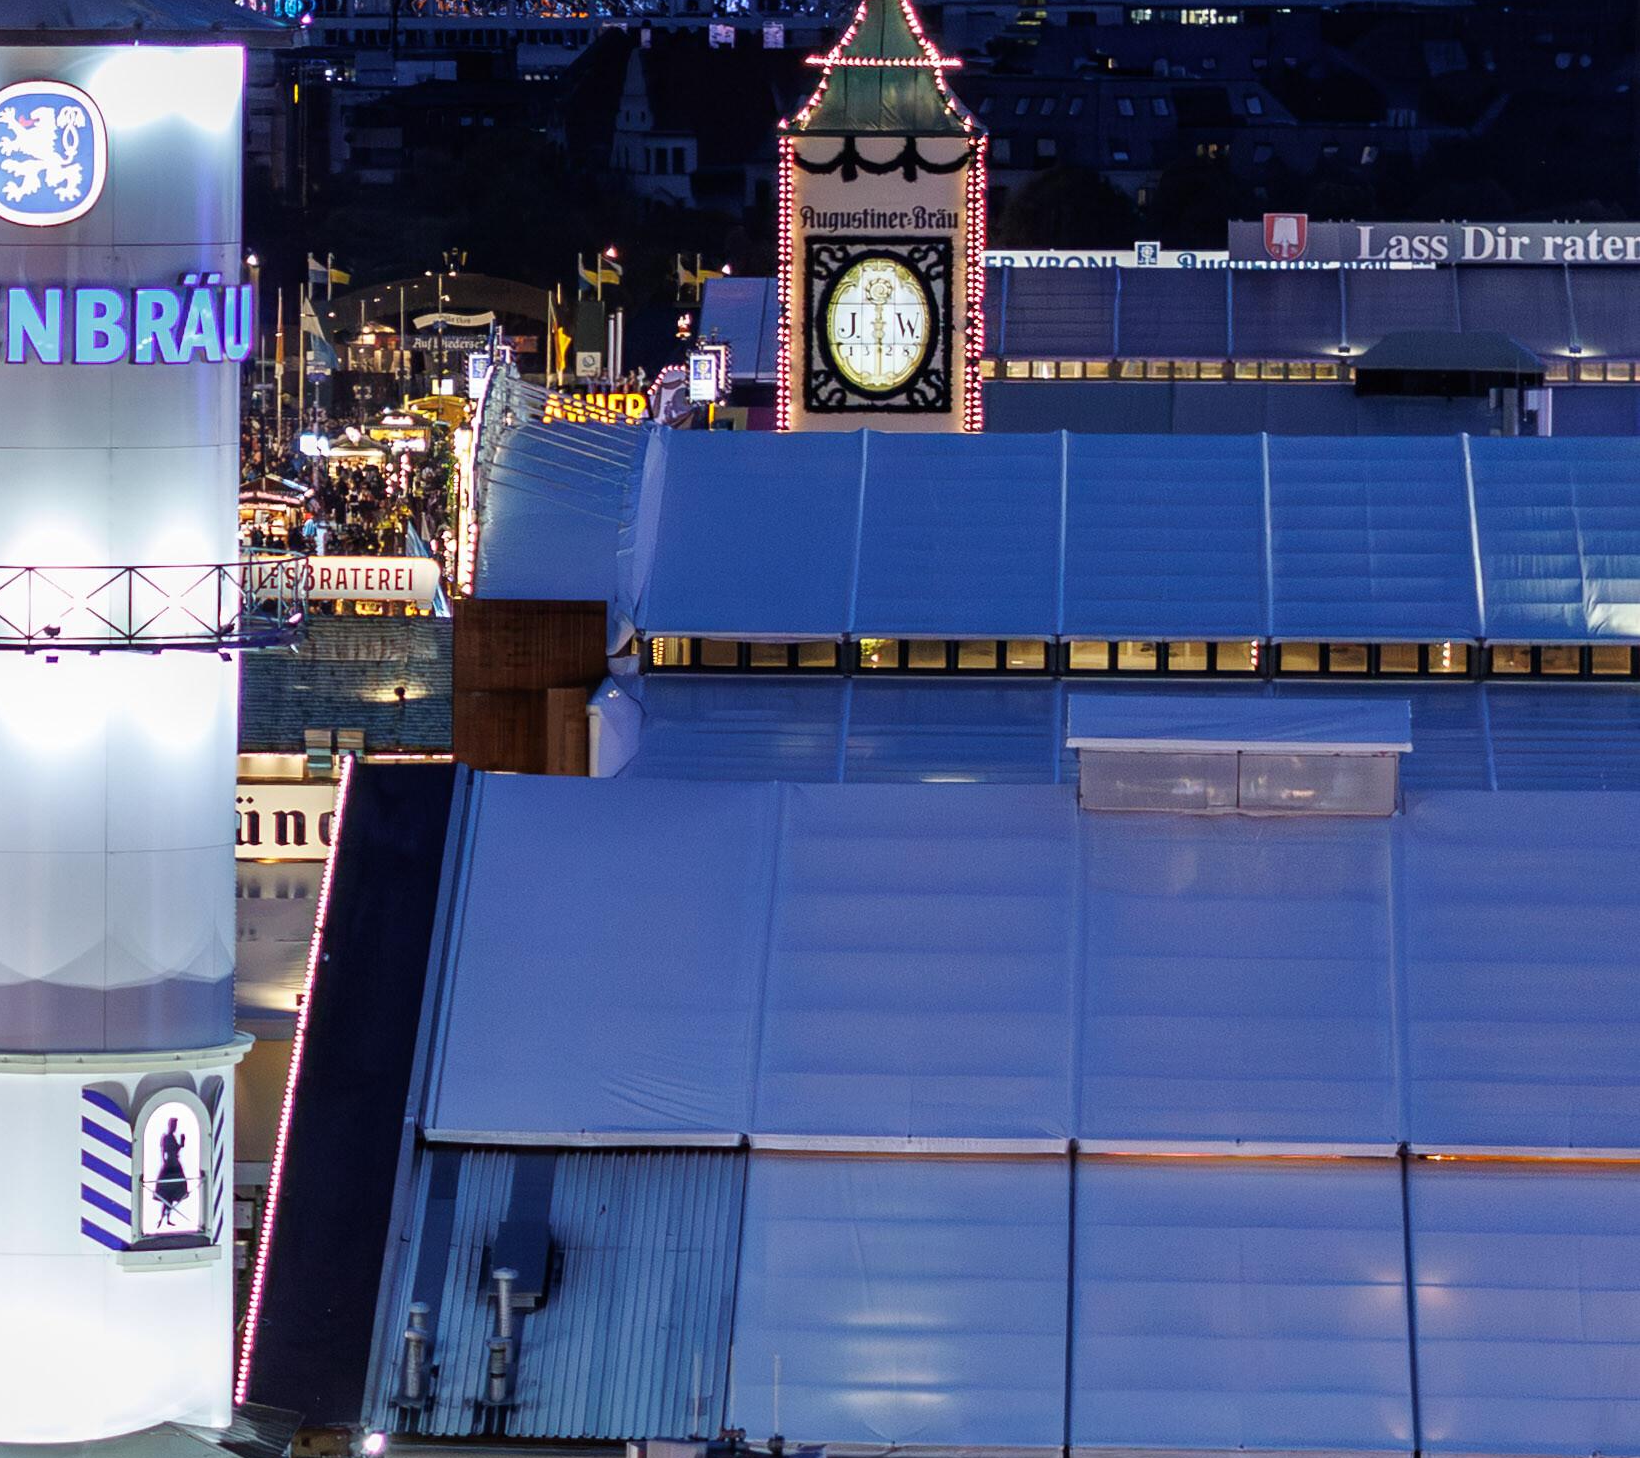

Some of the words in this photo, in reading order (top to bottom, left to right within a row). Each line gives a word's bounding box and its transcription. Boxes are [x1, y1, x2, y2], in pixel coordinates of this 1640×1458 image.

[800, 204, 959, 233] Augustiner-Bräu
[1358, 227, 1448, 262] Lass
[1461, 225, 1531, 262] Dir
